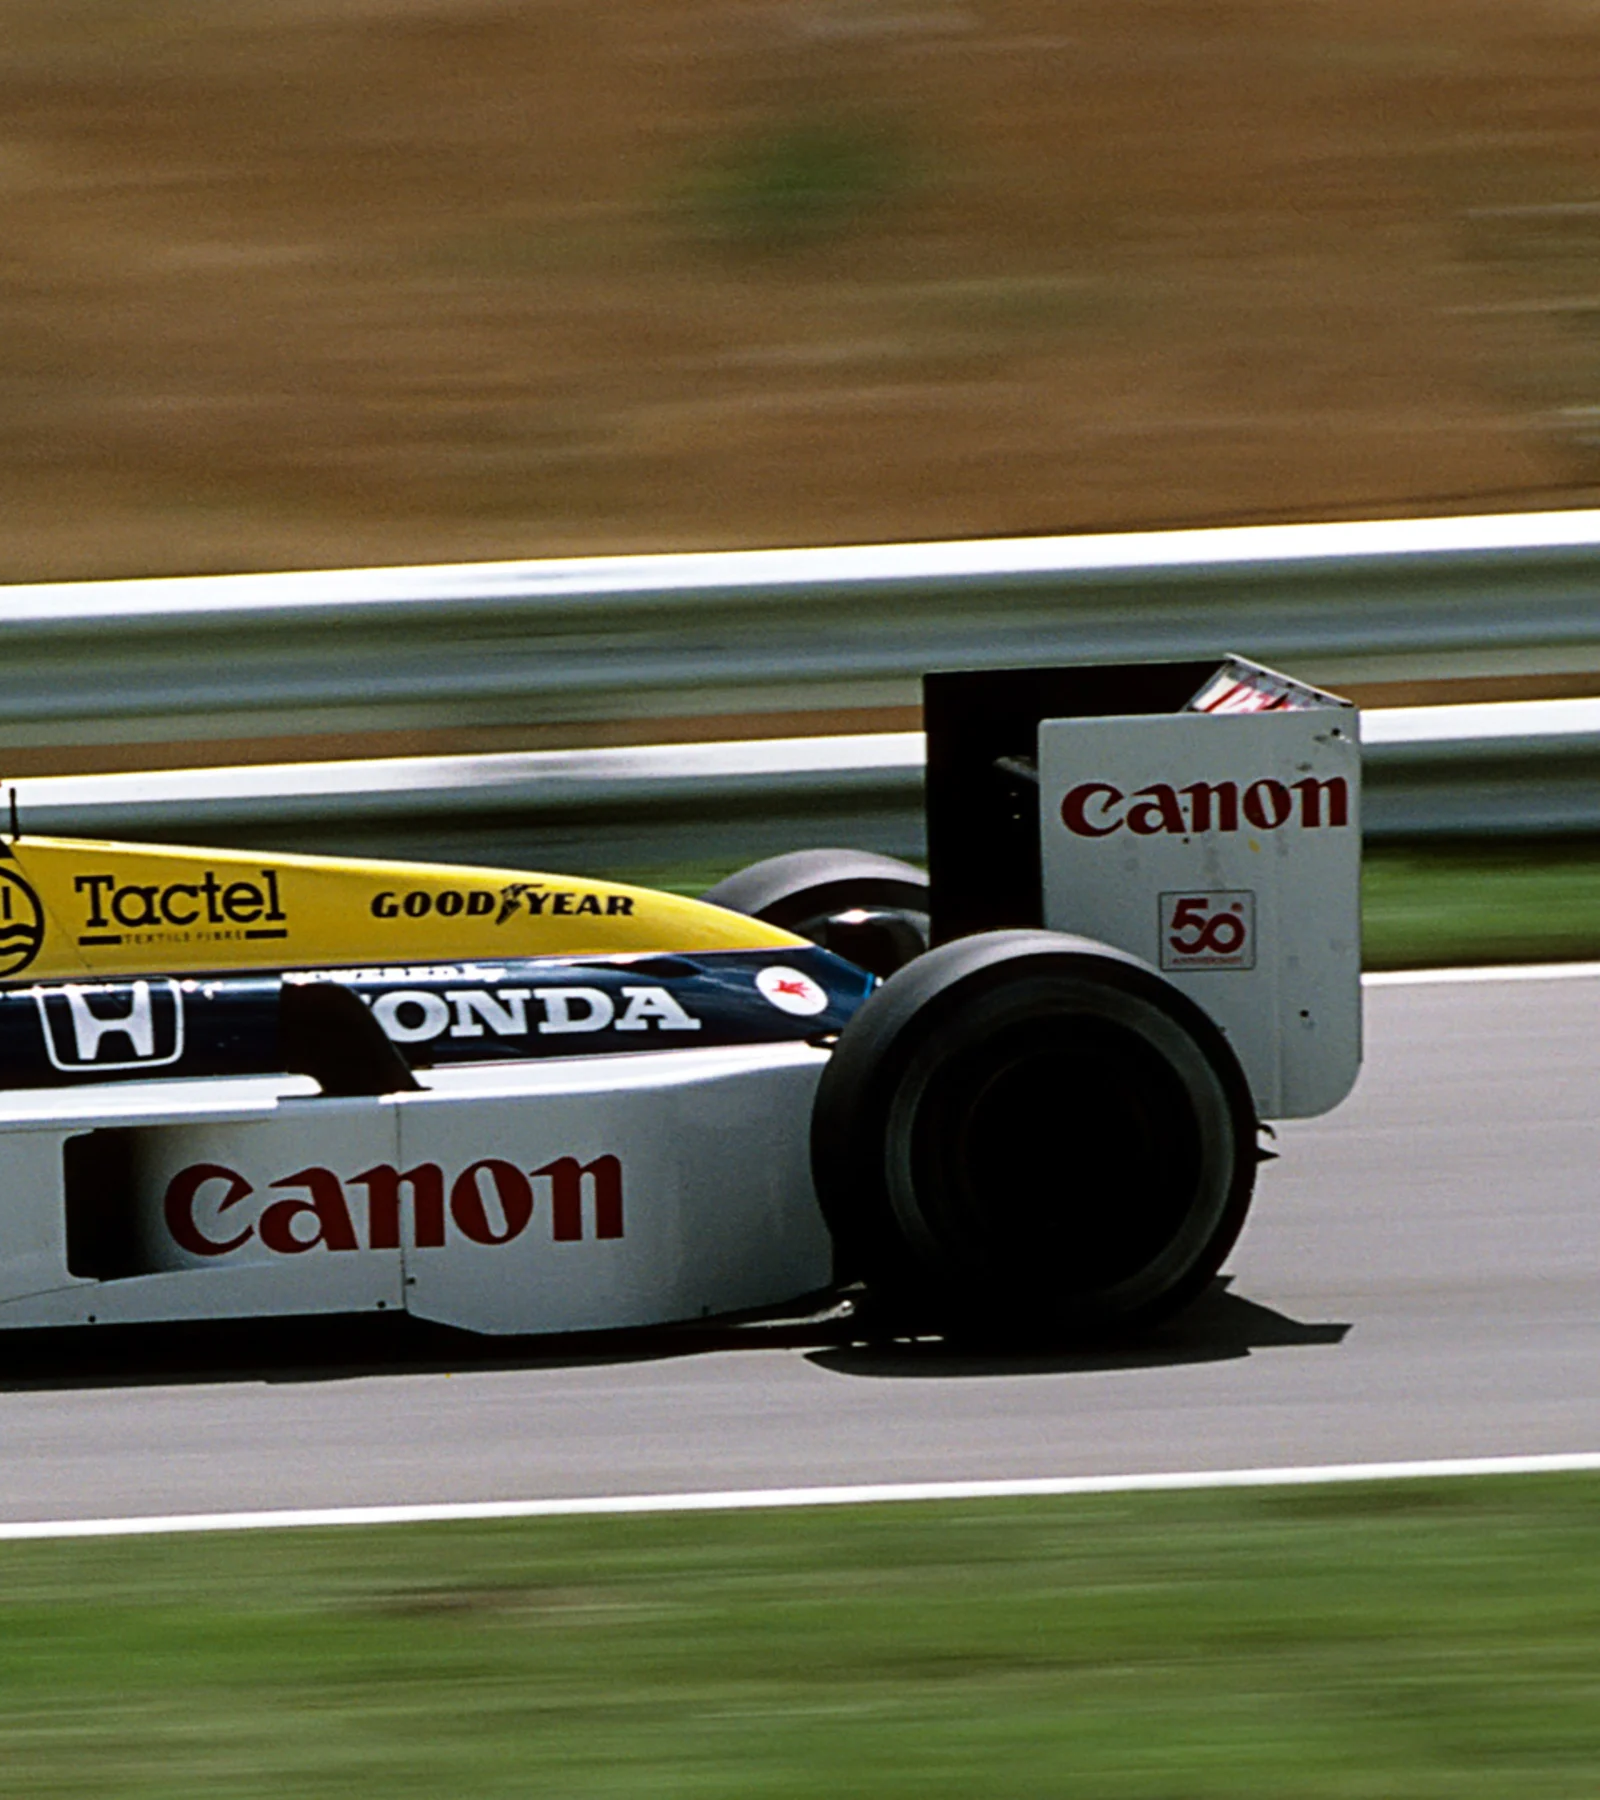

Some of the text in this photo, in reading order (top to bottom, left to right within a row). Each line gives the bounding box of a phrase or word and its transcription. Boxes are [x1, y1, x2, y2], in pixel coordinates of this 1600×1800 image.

[1061, 776, 1349, 838] Canon
[74, 870, 287, 928] Tactel
[1169, 897, 1247, 955] 50
[364, 987, 701, 1043] ONDA
[163, 1154, 625, 1257] Canon
